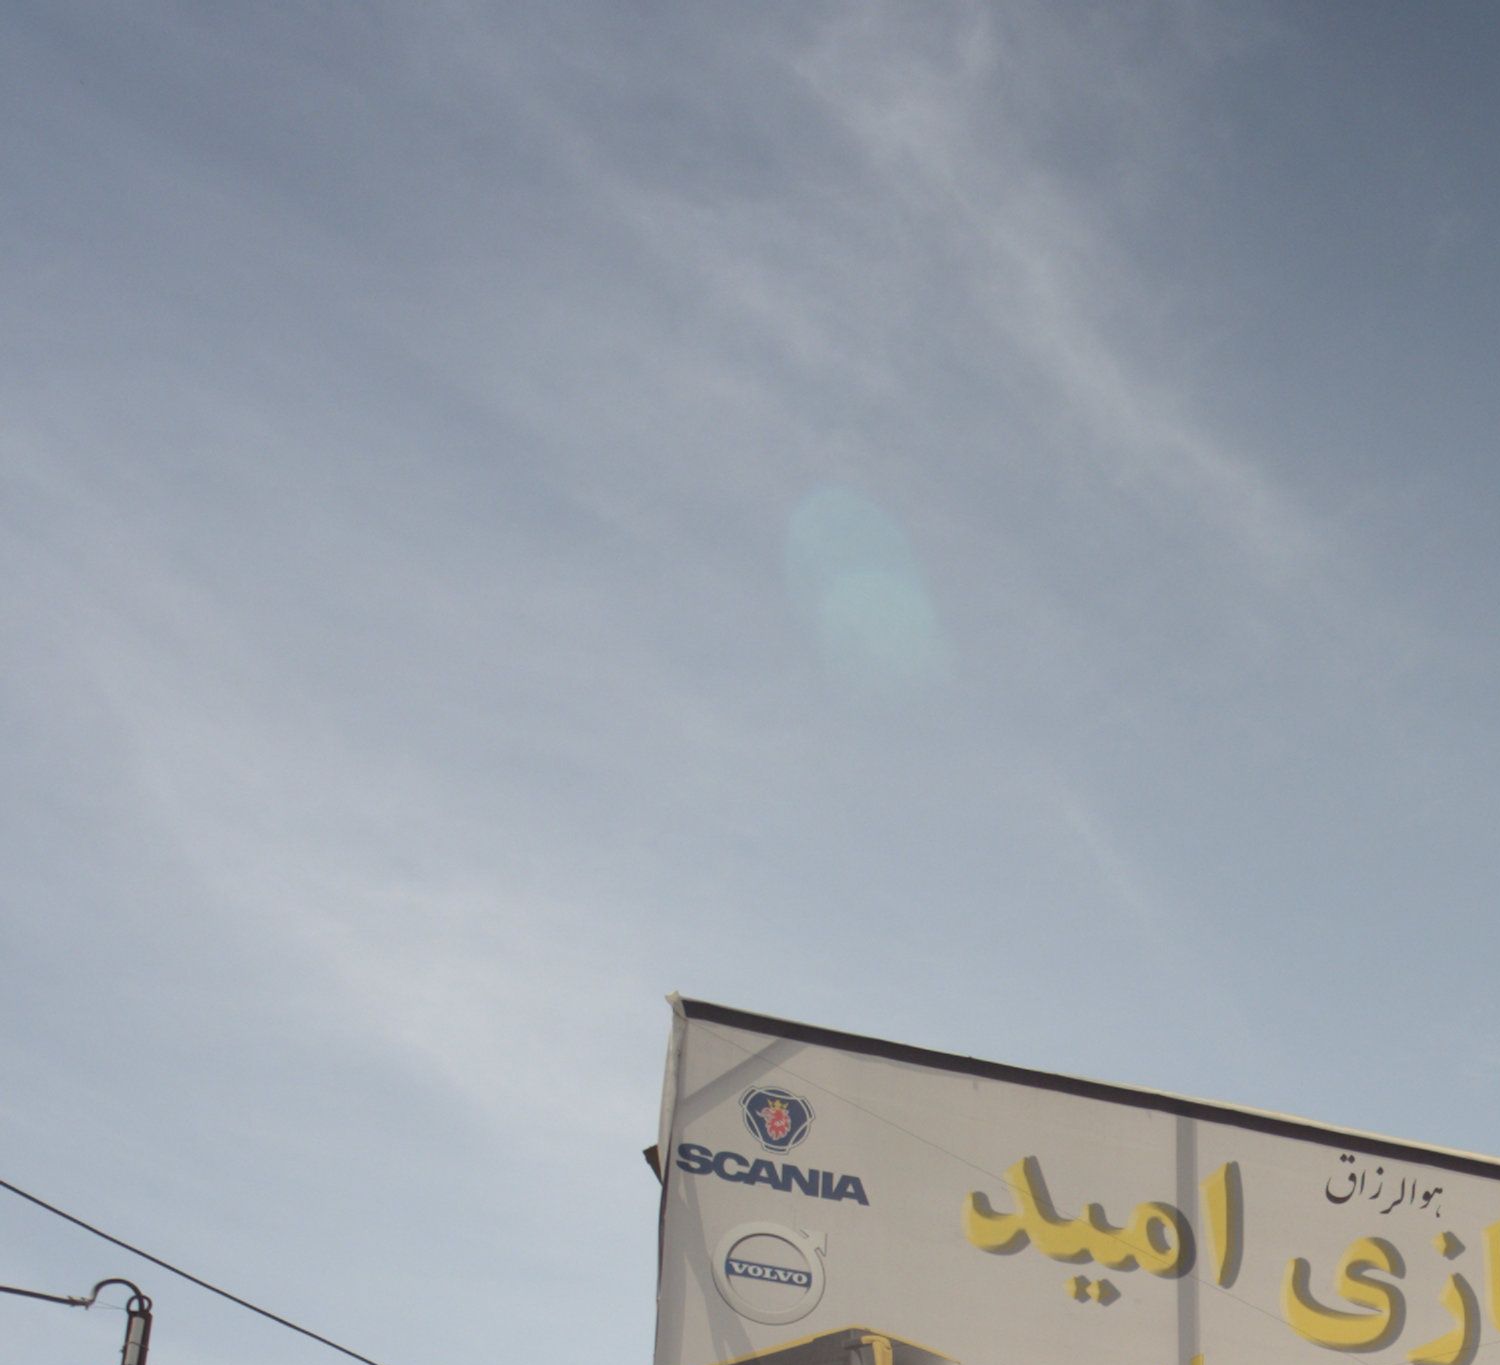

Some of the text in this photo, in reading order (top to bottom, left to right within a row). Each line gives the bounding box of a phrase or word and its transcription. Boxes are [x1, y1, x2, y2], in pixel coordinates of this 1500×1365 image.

[676, 1143, 869, 1206] SCANIA
[961, 1155, 1245, 1308] امید
[729, 1260, 808, 1285] VOLVO
